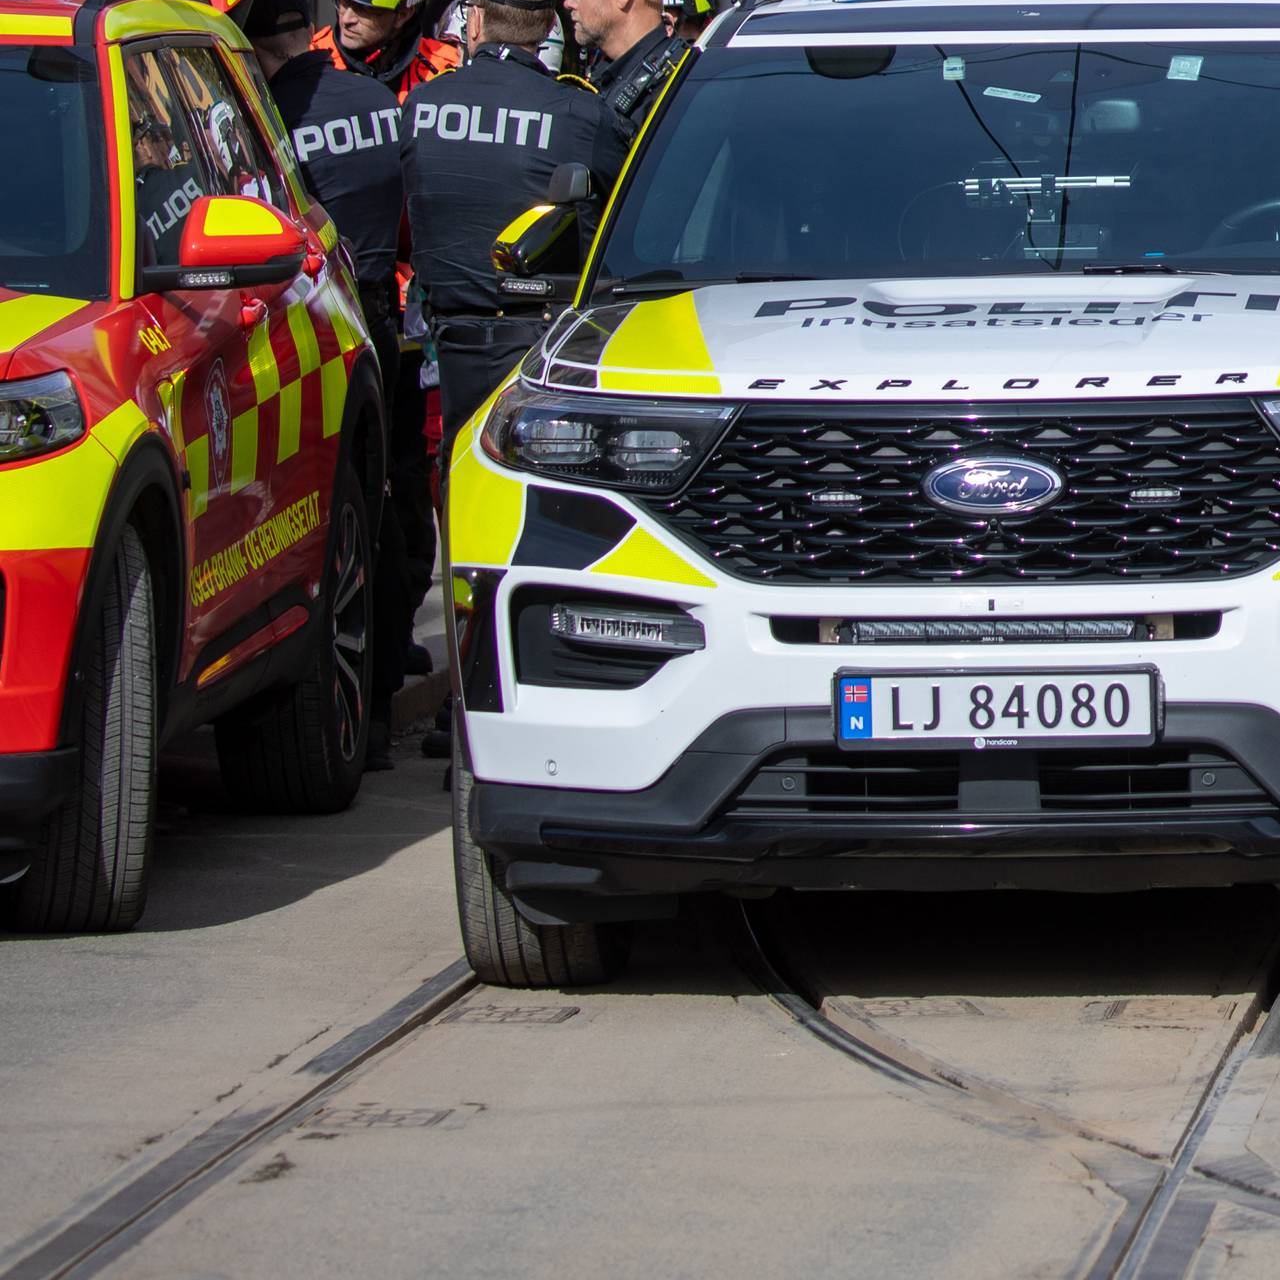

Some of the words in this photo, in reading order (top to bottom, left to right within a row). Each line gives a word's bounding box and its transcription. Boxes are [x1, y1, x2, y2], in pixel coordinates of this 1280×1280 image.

[412, 103, 553, 150] POLITI
[748, 373, 1250, 391] EXPLORER
[957, 469, 1029, 499] Ford
[190, 558, 216, 607] OSLO
[256, 489, 321, 561] REDNINGSETAT
[849, 716, 864, 730] N
[891, 684, 941, 731] LJ
[968, 682, 1130, 730] 84080
